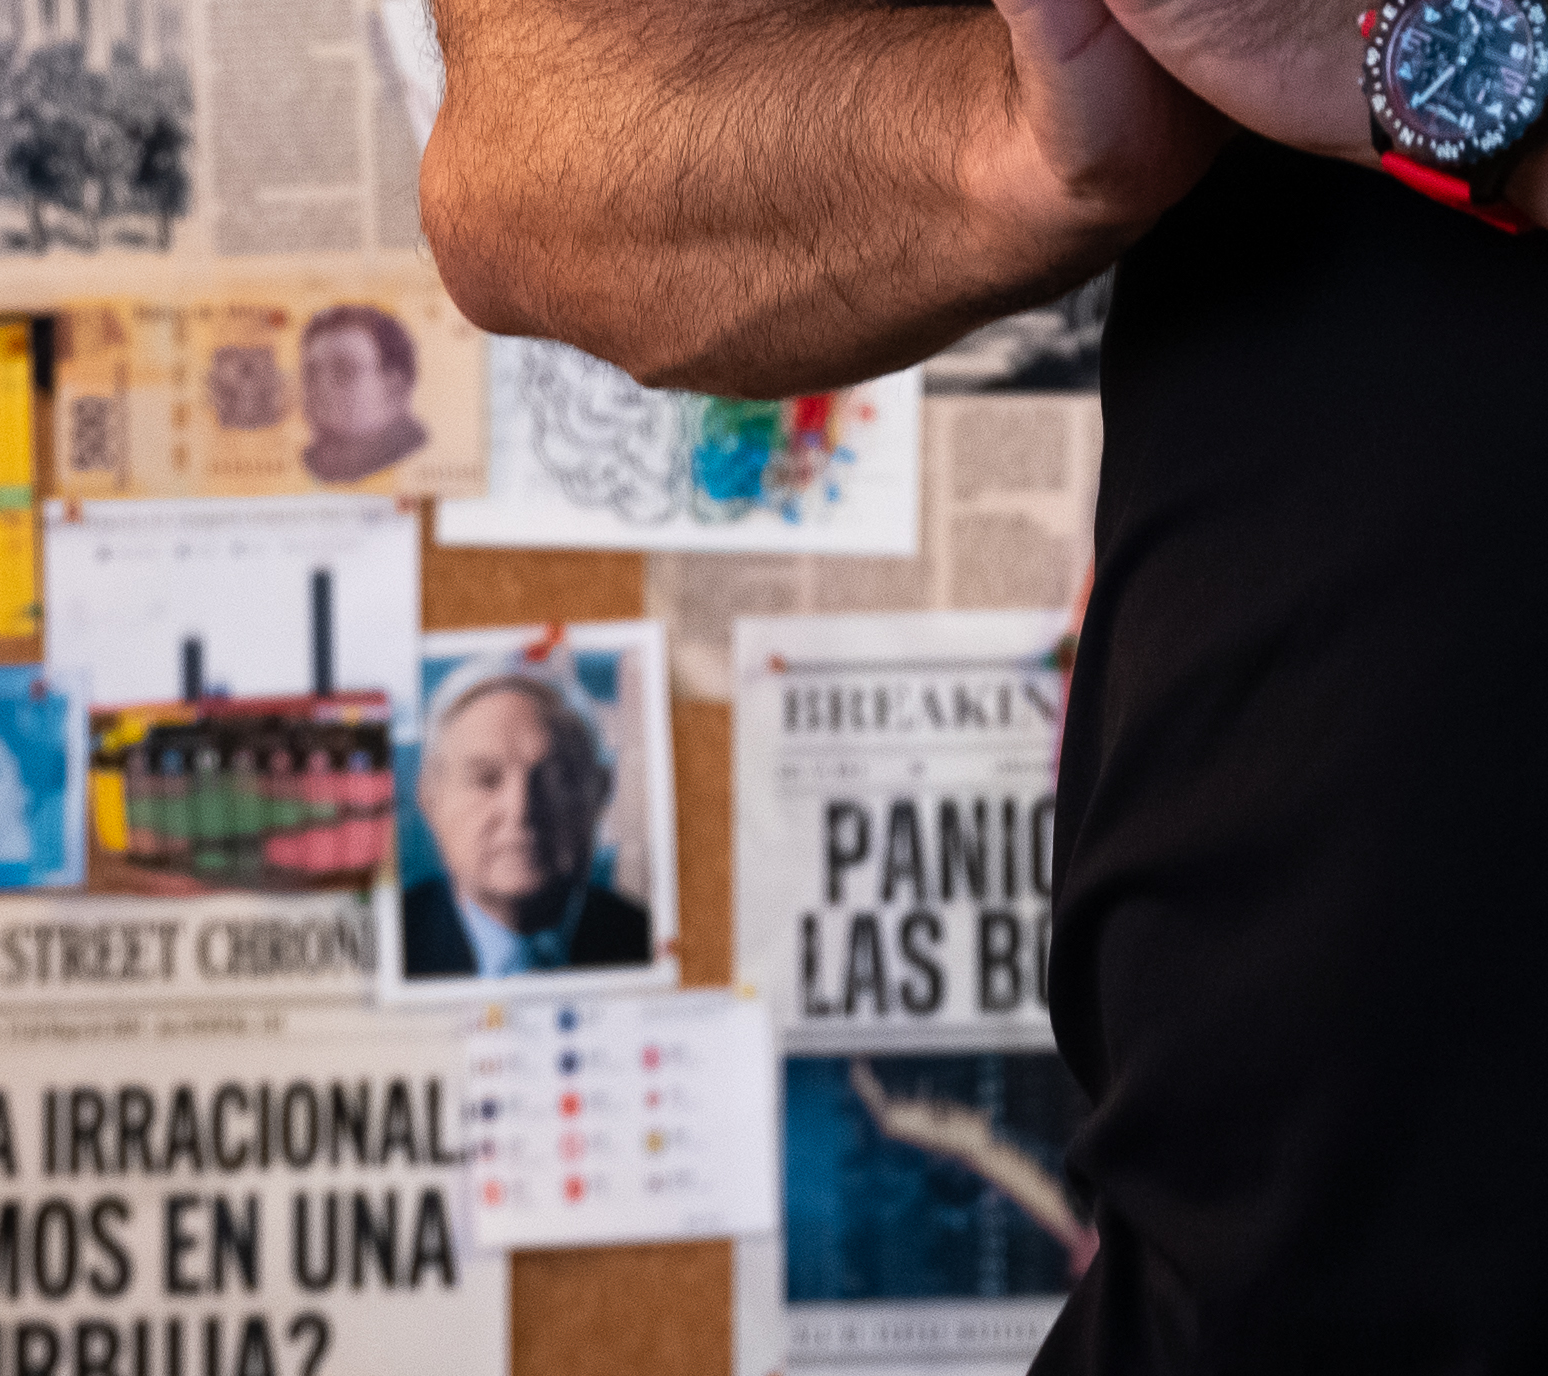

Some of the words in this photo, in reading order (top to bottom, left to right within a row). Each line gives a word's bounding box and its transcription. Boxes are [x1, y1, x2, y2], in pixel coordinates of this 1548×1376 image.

[1, 918, 178, 987] STREET
[801, 910, 946, 1022] LAS
[163, 1189, 259, 1298] EN
[292, 1185, 456, 1293] UNA
